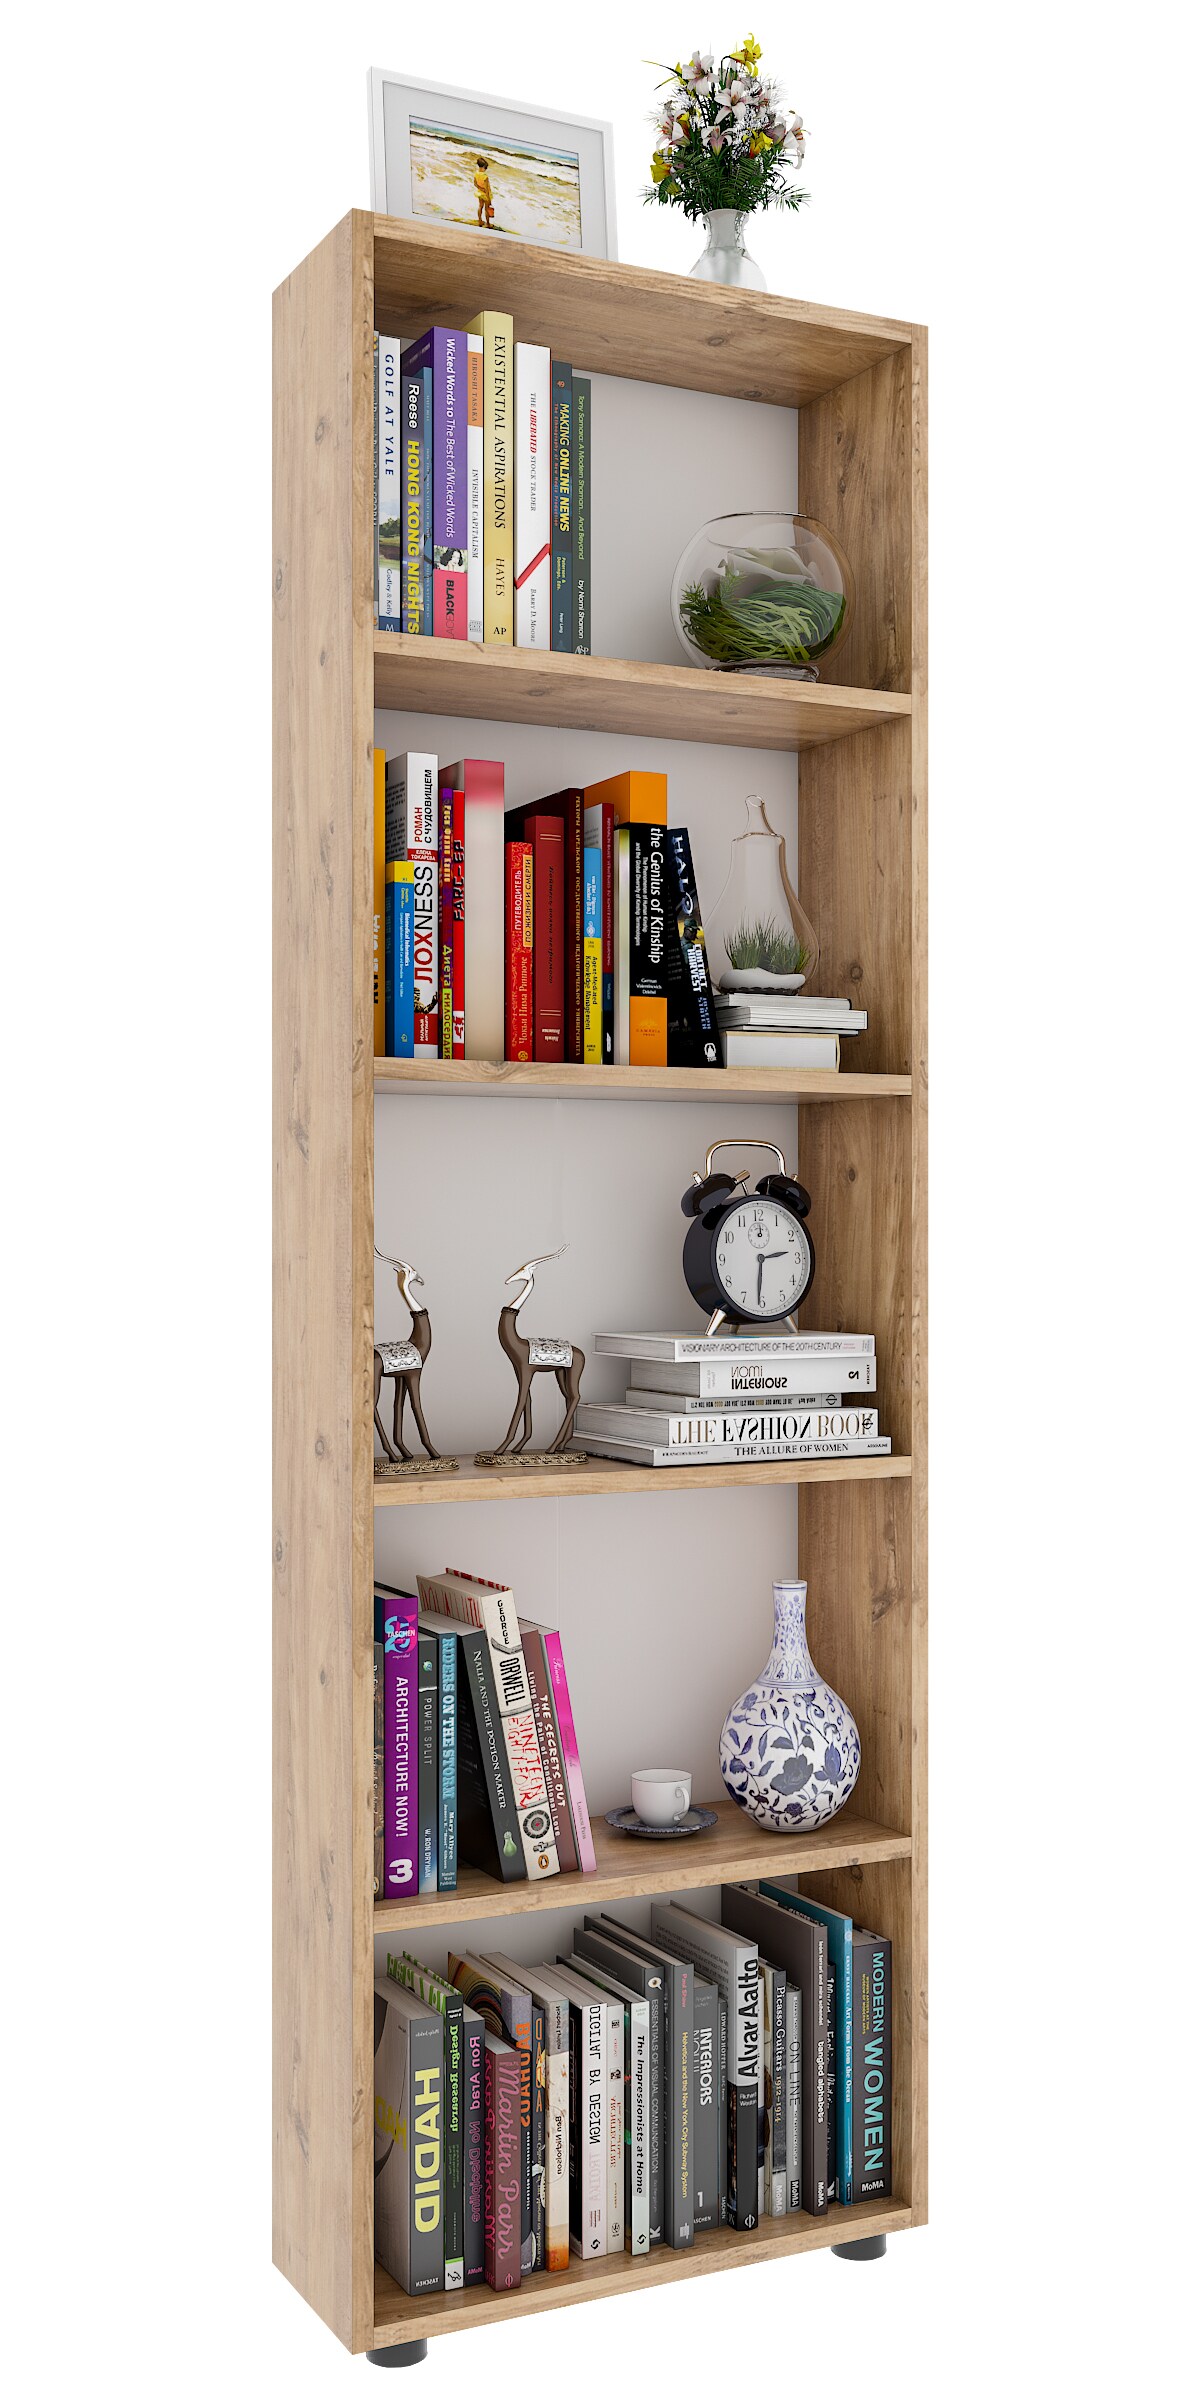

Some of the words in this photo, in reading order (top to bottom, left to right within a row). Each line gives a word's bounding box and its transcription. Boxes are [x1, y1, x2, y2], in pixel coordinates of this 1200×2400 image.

[446, 338, 456, 374] Wicked
[385, 354, 394, 397] GOLF
[446, 375, 456, 405] Words
[471, 357, 479, 391] HIROSHI
[494, 335, 506, 431] EXISTENTIAL
[385, 406, 394, 427] AT
[408, 384, 420, 429] Reese
[446, 406, 456, 417] 10
[471, 393, 479, 422] TASAKA
[577, 395, 585, 411] Tony
[446, 420, 456, 437] The
[529, 409, 537, 453] LIBERATED
[560, 403, 570, 446] MAKING
[385, 436, 394, 476] YALE
[446, 438, 456, 459] Best
[407, 440, 420, 496] HONG
[445, 461, 456, 472] of
[494, 437, 506, 529] ASPIRATIONS
[560, 448, 570, 493] ONLINE
[446, 471, 456, 507] Wicked
[471, 469, 479, 510] INVISIBLE
[407, 501, 420, 556] KONG
[446, 508, 456, 538] Words
[560, 496, 570, 534] NEWS
[471, 511, 479, 558] CAPITALISM
[577, 532, 585, 560] Beyond
[385, 568, 393, 593] Godley
[495, 558, 505, 596] HAYES
[577, 580, 585, 590] by
[407, 562, 420, 634] NIGHTS
[446, 580, 455, 616] BLACK
[494, 627, 507, 635] AP
[424, 769, 433, 835] ЧУДОВИЩЕМ
[414, 807, 423, 843] РОМАН
[650, 828, 664, 848] the
[650, 851, 664, 895] Genius
[672, 834, 694, 916] HALO
[514, 870, 522, 930] ПУТЕВОДИТЕЛЬ
[650, 898, 664, 912] of
[525, 930, 531, 943] ПО
[647, 916, 664, 963] Kinship
[442, 944, 452, 987] Диета
[687, 947, 702, 992] HARVEST
[694, 943, 708, 988] CONTACT
[442, 992, 451, 1060] милосердия
[738, 1215, 746, 1227] 11
[753, 1210, 764, 1222] 12
[725, 1231, 734, 1244] 10
[787, 1231, 795, 1242] 2
[719, 1254, 726, 1266] 9
[794, 1252, 801, 1264] 3
[725, 1275, 732, 1288] 8
[779, 1290, 786, 1302] 5
[789, 1274, 797, 1285] 4
[741, 1291, 747, 1304] 7
[759, 1296, 766, 1308] 6
[682, 1343, 719, 1353] VISIONARY
[720, 1342, 771, 1352] ARCHITECTURE
[772, 1342, 781, 1351] OF
[781, 1342, 795, 1351] THE
[814, 1341, 843, 1351] CENTURY
[734, 1447, 757, 1456] THE
[759, 1445, 799, 1455] ALLURE
[800, 1445, 813, 1453] OF
[814, 1443, 849, 1452] WOMEN
[497, 1599, 509, 1645] GEORGE
[442, 1637, 455, 1692] RIDERS
[500, 1657, 525, 1706] ORWELL
[528, 1671, 538, 1699] Living
[424, 1697, 432, 1732] POWER
[442, 1694, 455, 1714] ON
[533, 1703, 541, 1713] the
[540, 1694, 552, 1719] THE
[396, 1676, 408, 1792] ARCHITECTURE
[442, 1717, 455, 1747] THE
[536, 1721, 546, 1743] Pain
[424, 1736, 432, 1765] SPLIT
[540, 1746, 548, 1755] of
[544, 1723, 562, 1779] SECRETS
[442, 1749, 455, 1800] STORM
[542, 1759, 558, 1812] Conditional
[556, 1783, 566, 1807] OUT
[396, 1796, 408, 1837] NOW!
[551, 1815, 561, 1836] Love
[388, 1859, 413, 1883] 3
[738, 1958, 759, 2018] Aalto
[872, 1951, 885, 2033] MODERN
[776, 1986, 786, 2027] Picasso
[651, 1998, 659, 2051] ESSENTIALS
[636, 2035, 645, 2056] The
[651, 2053, 659, 2065] OF
[738, 2021, 759, 2078] Alvar
[776, 2028, 786, 2072] Guitars
[816, 2041, 825, 2076] tangled
[651, 2066, 659, 2096] VISUAL
[700, 2028, 712, 2106] INTERIORS
[498, 2061, 520, 2174] Martin
[636, 2059, 645, 2143] Impressionists
[816, 2078, 825, 2123] alphabets
[864, 2036, 884, 2172] WOMEN
[636, 2145, 645, 2158] at
[651, 2098, 659, 2173] COMMUNICATION
[636, 2161, 645, 2194] Home
[791, 2181, 799, 2207] MoMA
[817, 2181, 825, 2207] MoMA
[861, 2181, 884, 2193] MoMA
[697, 2191, 703, 2207] 1
[775, 2184, 783, 2212] MoMA
[498, 2180, 519, 2259] Parr
